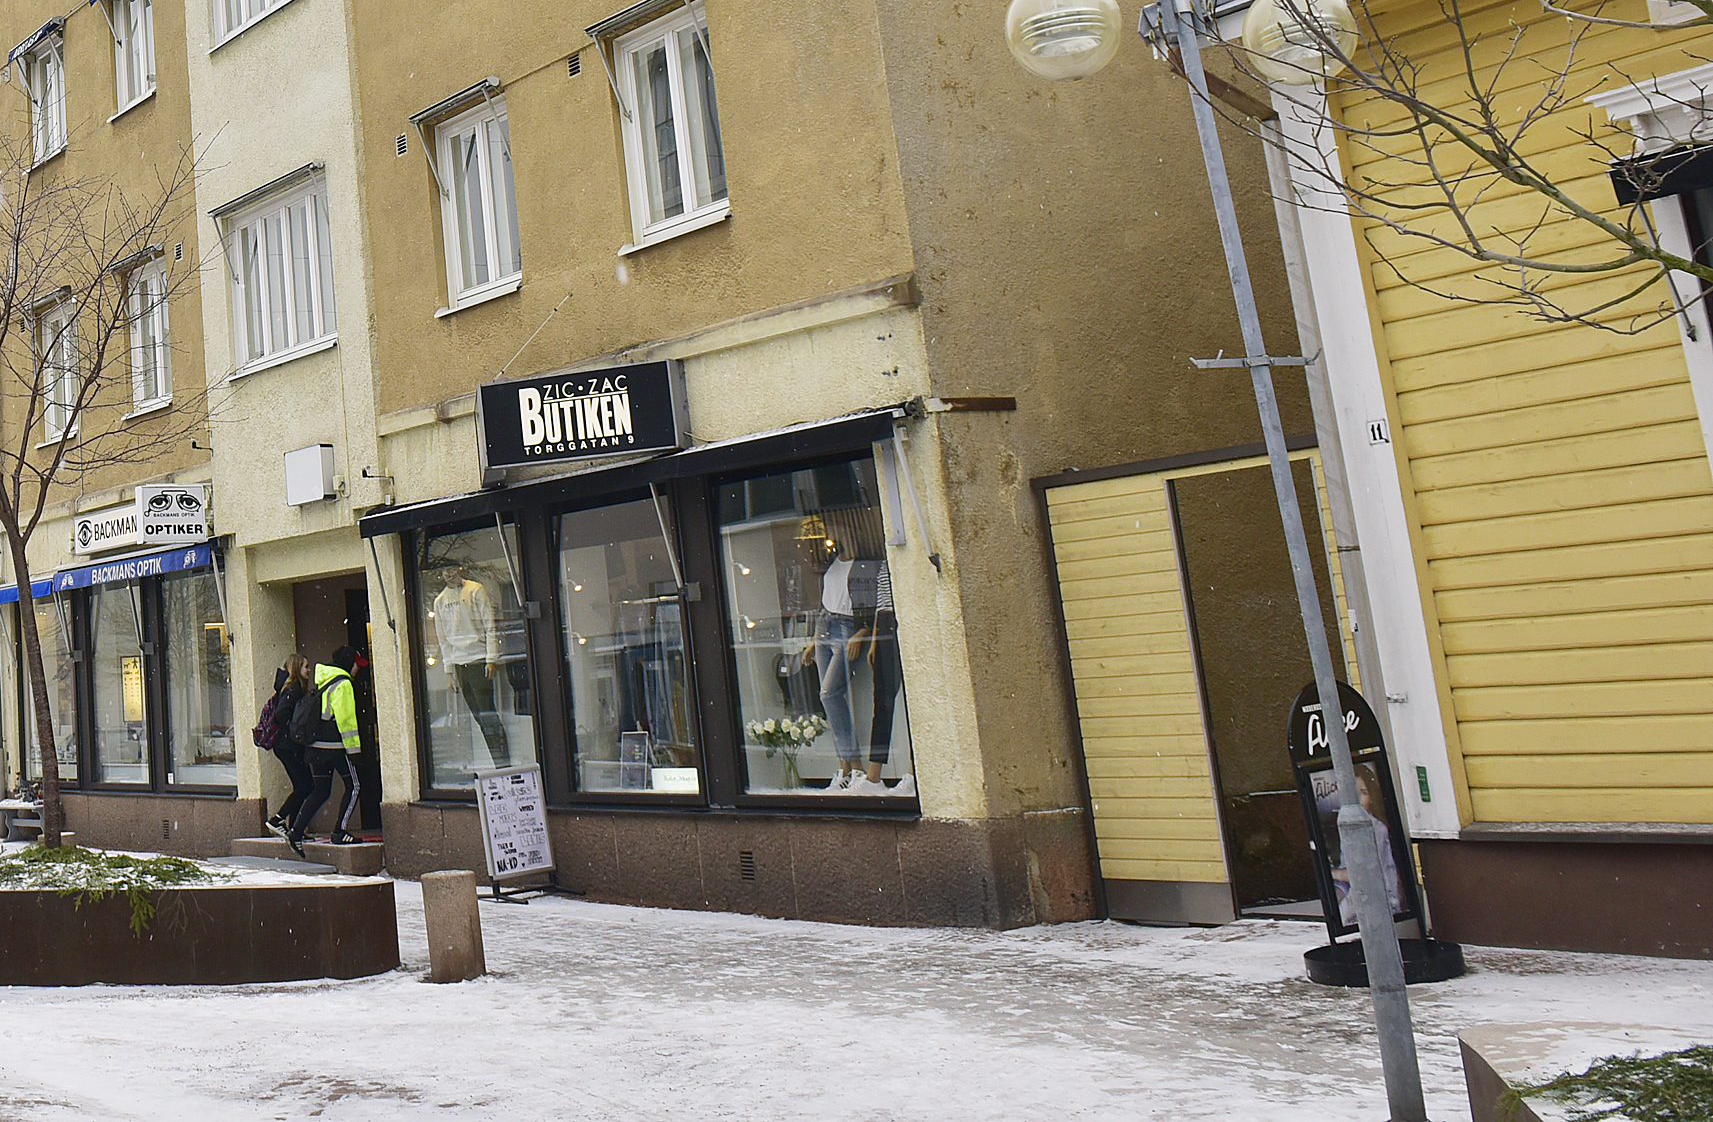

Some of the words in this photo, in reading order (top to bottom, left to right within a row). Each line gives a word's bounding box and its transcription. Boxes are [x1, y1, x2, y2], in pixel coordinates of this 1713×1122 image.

[543, 382, 575, 400] ZIC
[588, 375, 628, 395] ZAC
[518, 387, 633, 447] BUTIKEN
[524, 436, 620, 456] TORGGATAN
[628, 435, 635, 444] 9
[145, 524, 203, 535] OPTIKER
[91, 563, 136, 584] BACKMANS
[137, 557, 162, 576] OPTIK
